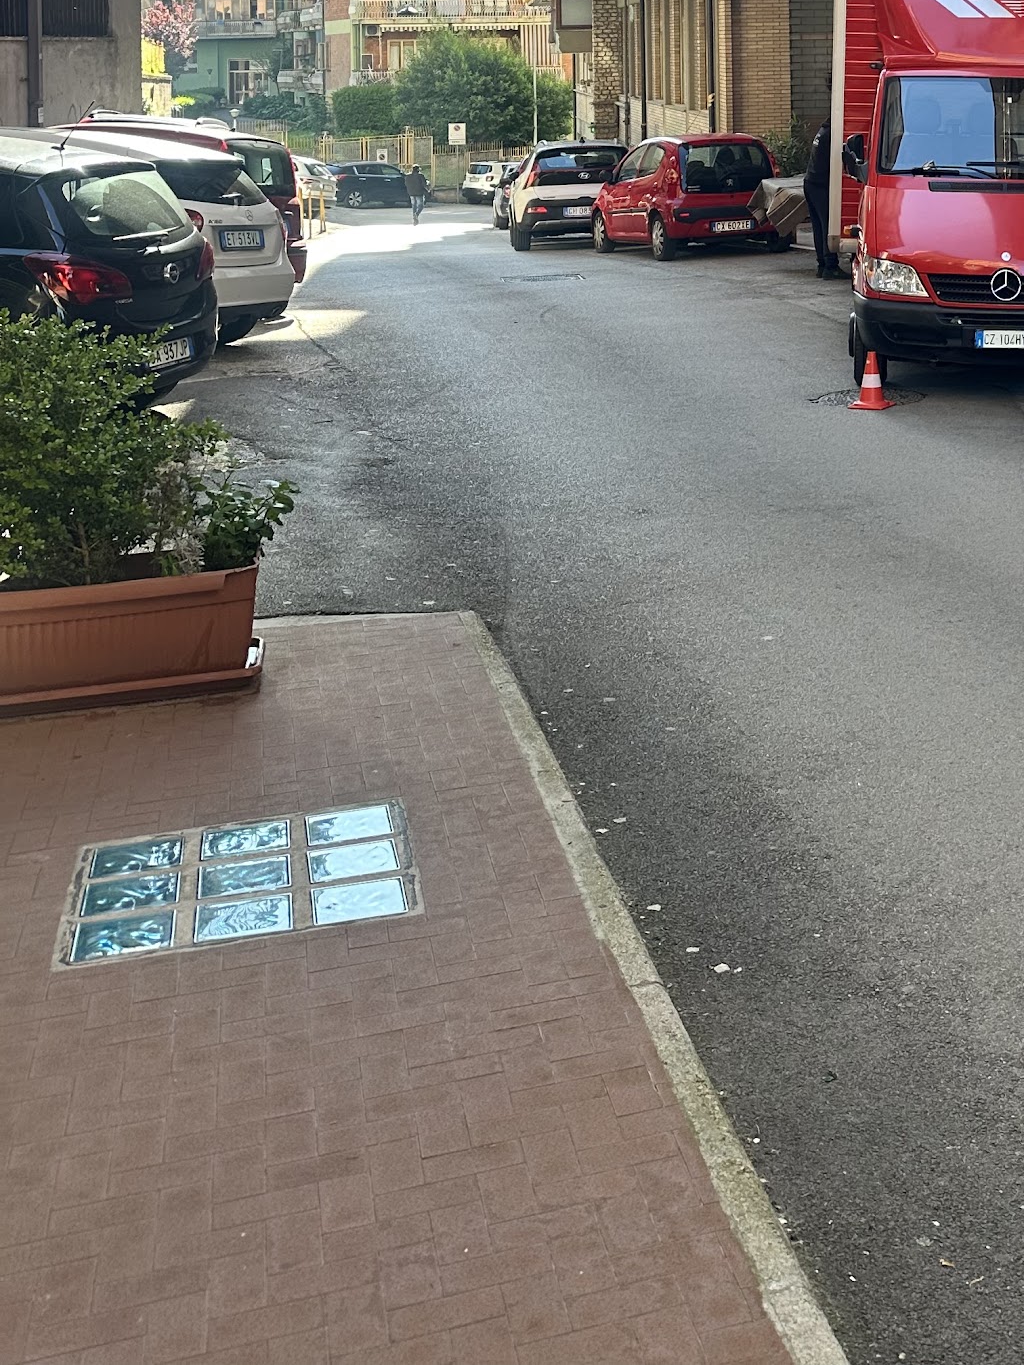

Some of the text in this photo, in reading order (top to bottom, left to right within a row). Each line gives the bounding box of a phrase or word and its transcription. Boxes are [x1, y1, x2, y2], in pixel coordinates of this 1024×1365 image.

[226, 232, 260, 246] ET 513VL
[984, 333, 996, 345] CZ
[163, 339, 188, 361] 937JP
